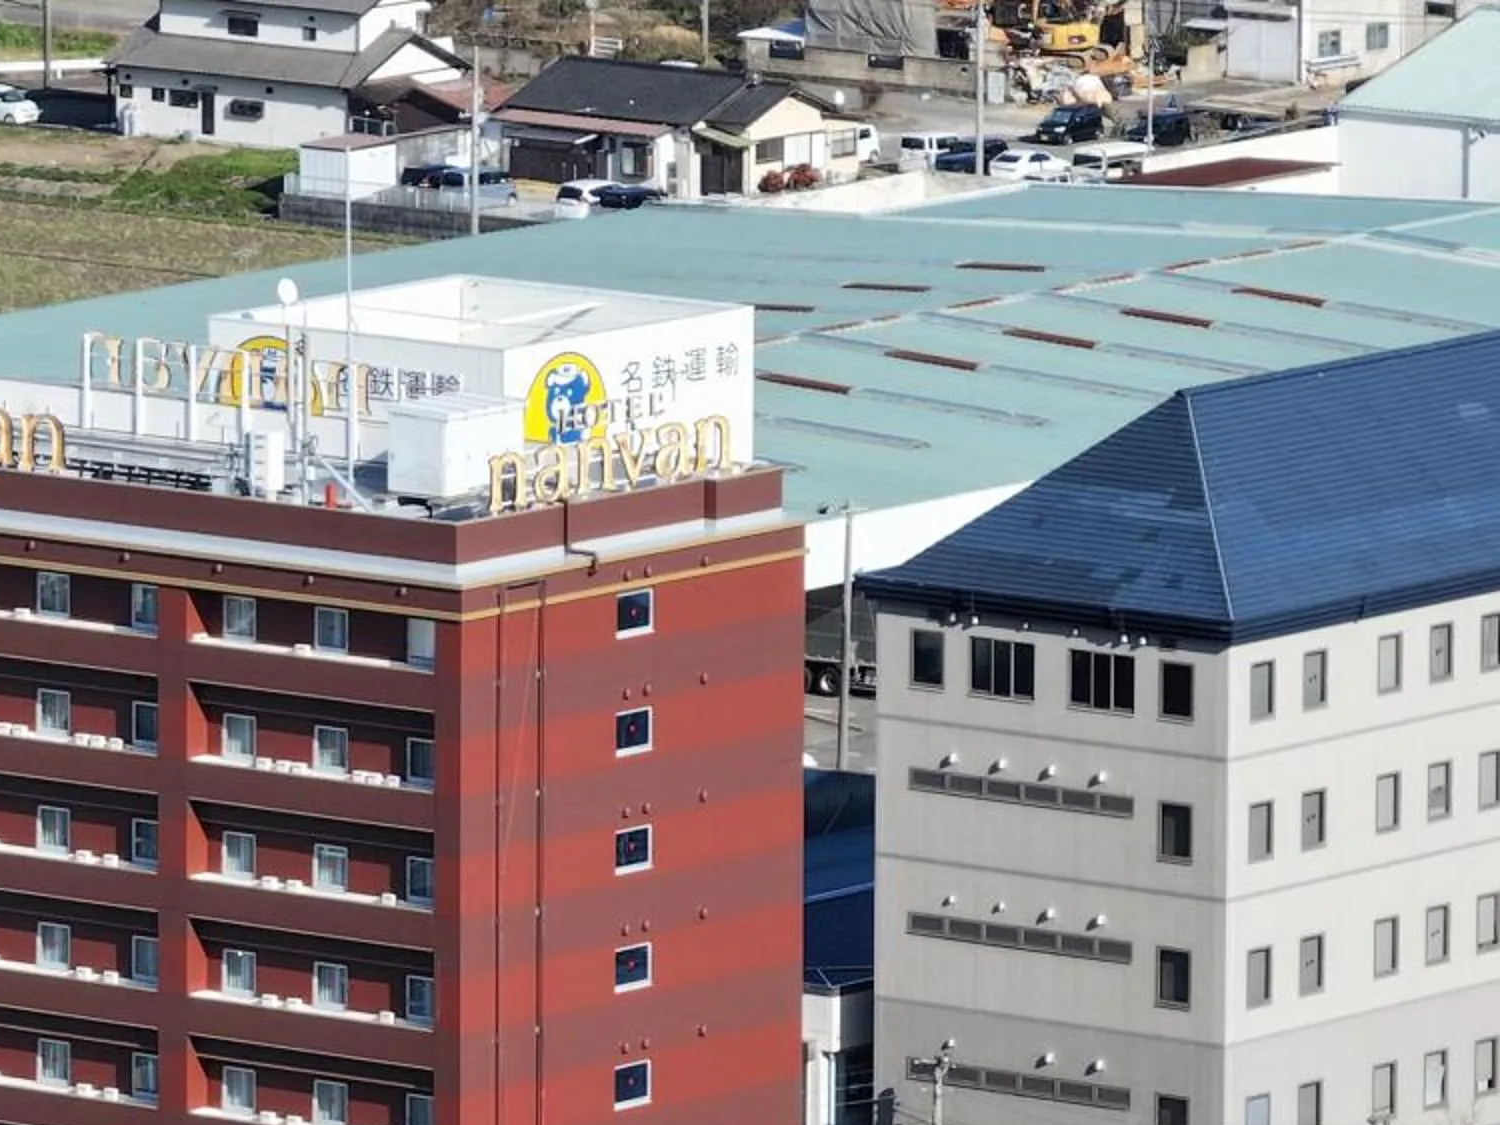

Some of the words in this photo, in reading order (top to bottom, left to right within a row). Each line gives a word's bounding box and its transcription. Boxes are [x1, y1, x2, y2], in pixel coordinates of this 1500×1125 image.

[620, 342, 739, 393] 名鉄運輸
[487, 413, 732, 513] nanvan
